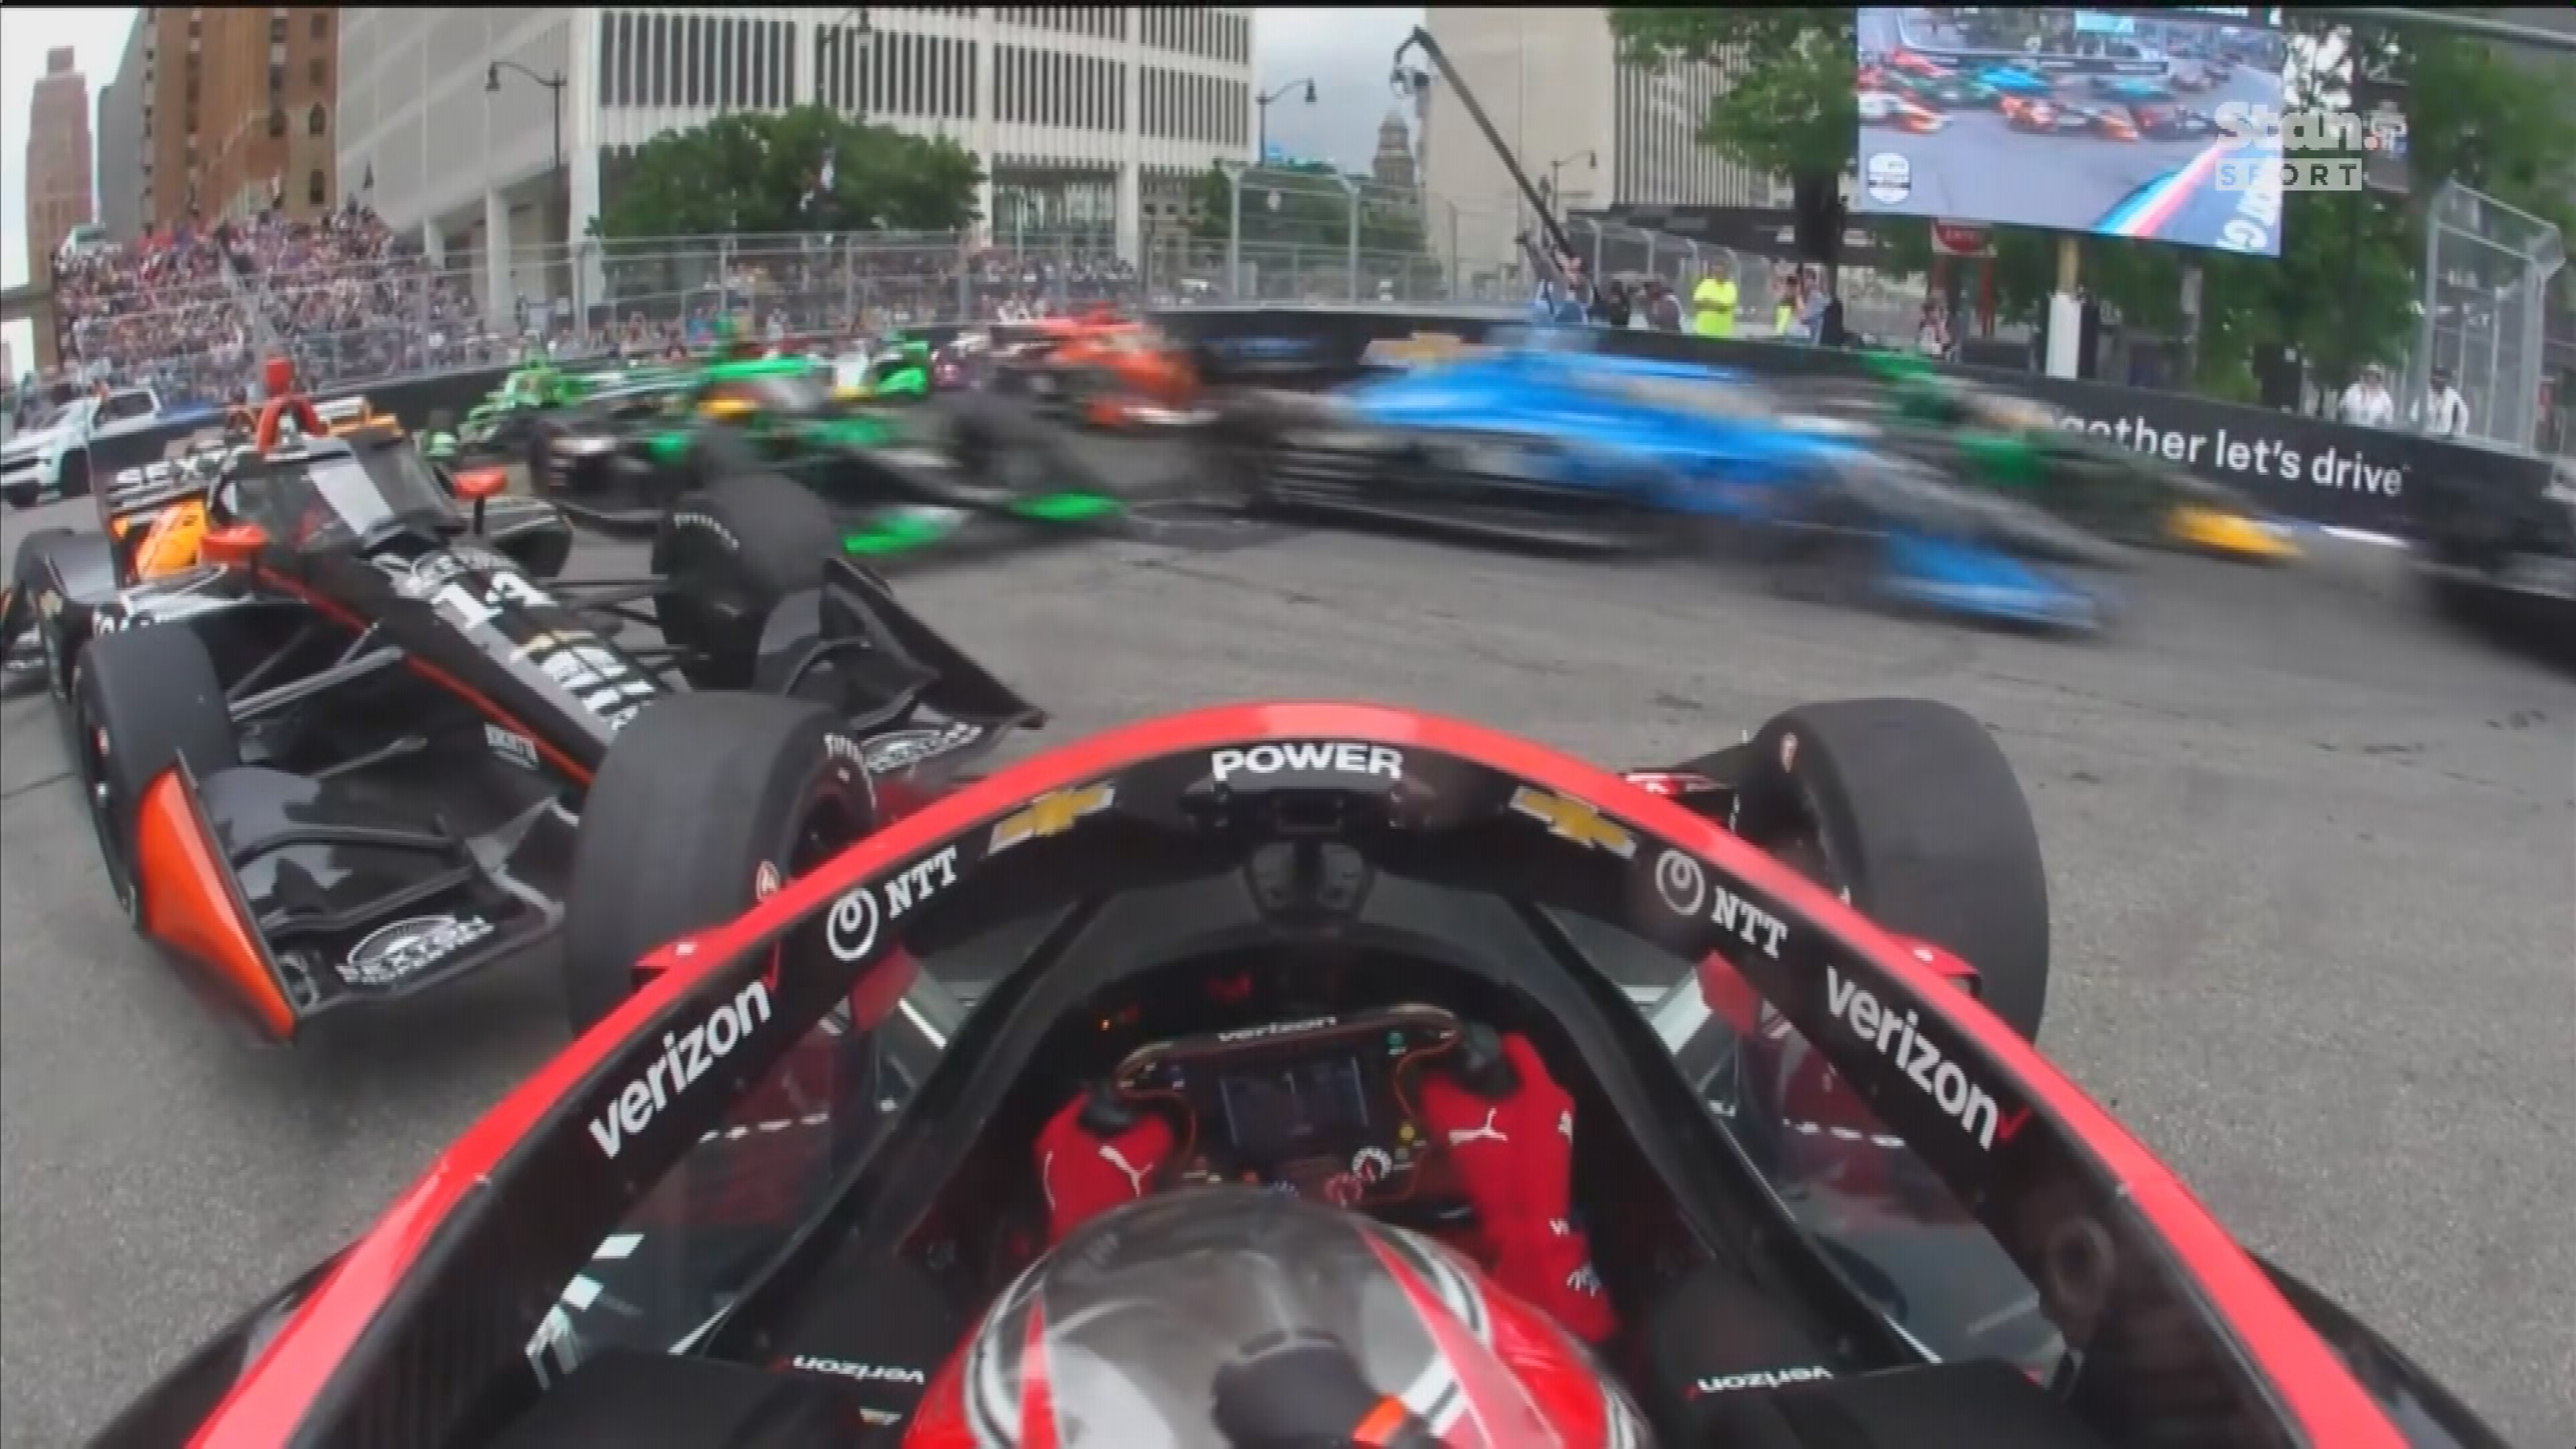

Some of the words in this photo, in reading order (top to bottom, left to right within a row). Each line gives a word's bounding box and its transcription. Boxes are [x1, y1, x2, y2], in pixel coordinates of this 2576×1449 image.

[2214, 429, 2302, 481] let's
[2311, 445, 2402, 497] drive
[1210, 742, 1404, 782] POWER
[885, 845, 957, 920] NTT
[1711, 885, 1788, 960] NTT
[1218, 1016, 1337, 1042] verizon
[1826, 964, 1999, 1150] verizon
[589, 977, 772, 1160] verizon
